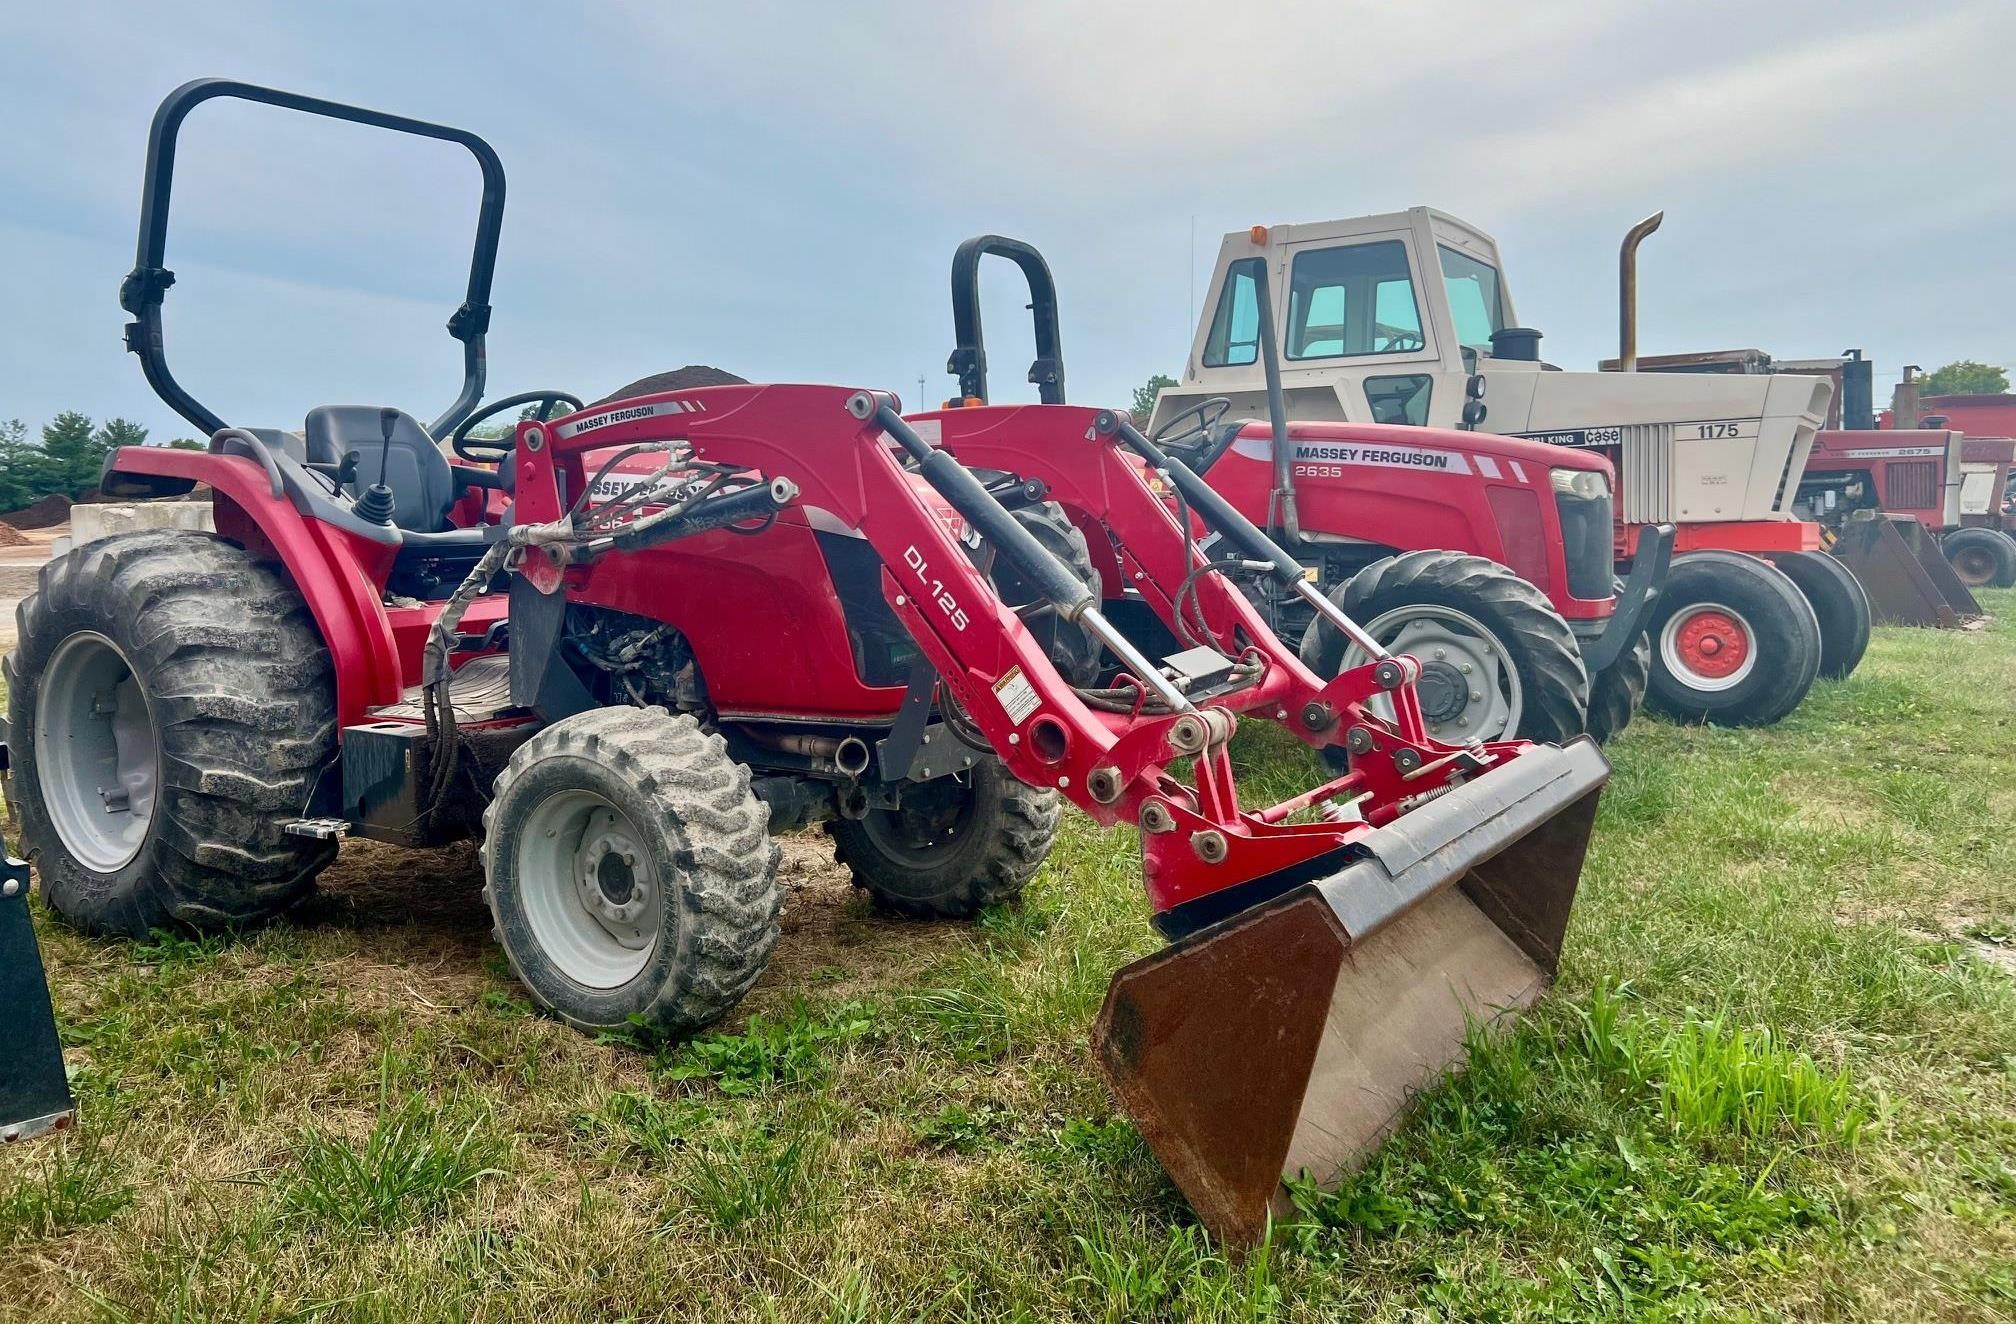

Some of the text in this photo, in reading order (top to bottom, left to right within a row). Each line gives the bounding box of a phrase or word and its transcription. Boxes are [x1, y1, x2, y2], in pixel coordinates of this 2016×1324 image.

[576, 406, 654, 433] MASSEY FERGUSON
[1548, 434, 1574, 444] KING
[1698, 423, 1738, 438] 1175
[1296, 447, 1448, 468] MASSEY FERGUSON
[1295, 465, 1342, 478] 2635
[903, 544, 970, 632] DL 125
